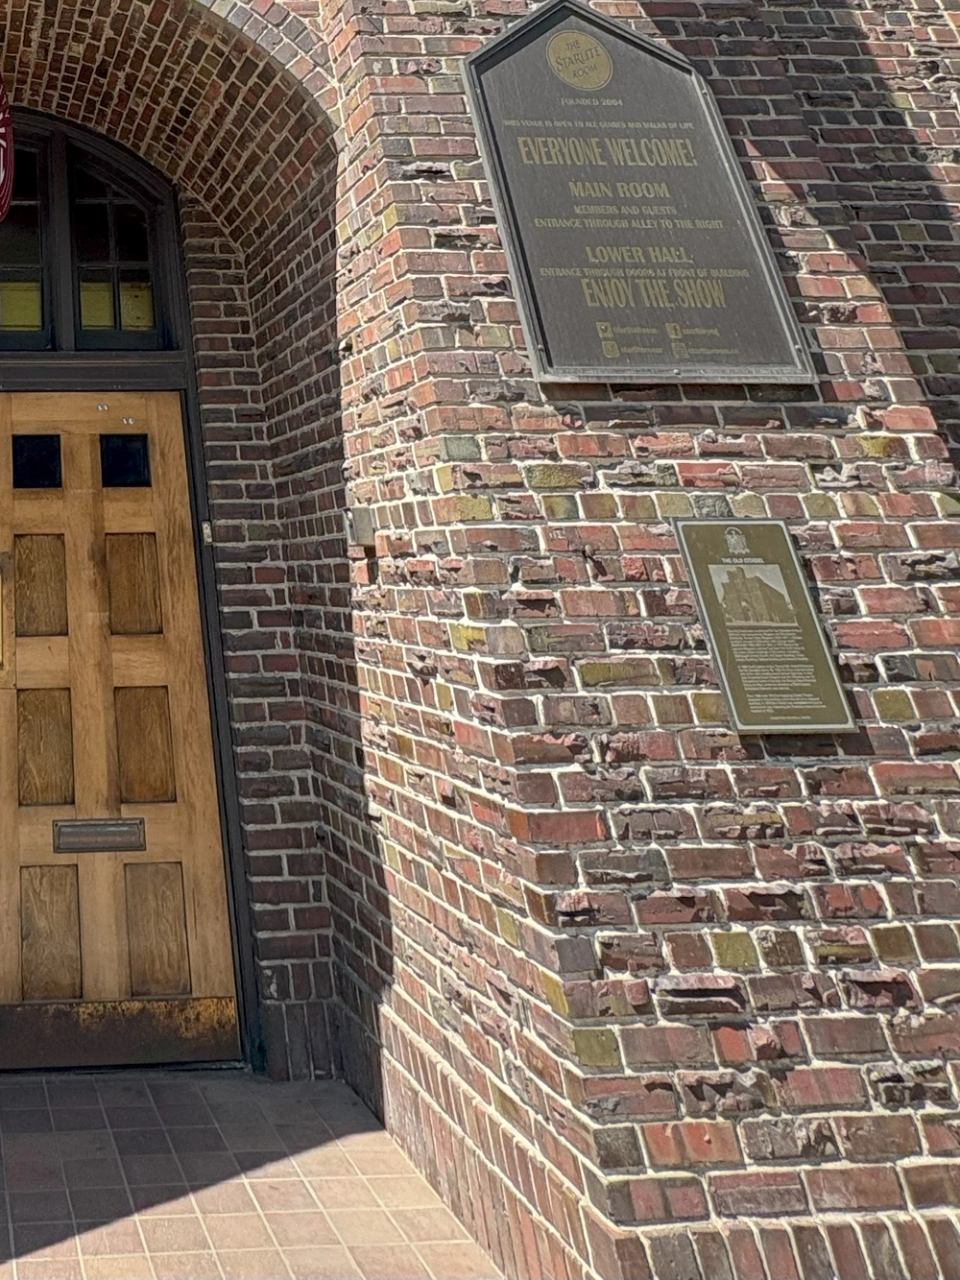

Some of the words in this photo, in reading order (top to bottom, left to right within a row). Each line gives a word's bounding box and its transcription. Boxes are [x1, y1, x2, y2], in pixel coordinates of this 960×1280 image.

[566, 40, 581, 51] THE
[555, 47, 600, 72] STARLITE
[573, 63, 599, 79] ROOM
[560, 97, 599, 106] FOUNDED
[517, 136, 608, 166] EVERYONE
[605, 136, 698, 167] WELCOME!
[568, 181, 613, 198] MAIN
[617, 182, 671, 198] ROOM
[574, 205, 617, 215] MEMBERS
[619, 206, 640, 215] AND
[641, 206, 678, 215] GUESTS
[534, 218, 583, 229] ENTRANCE
[584, 219, 630, 229] THROUGH
[631, 219, 659, 229] ALLEY
[660, 220, 672, 229] TO
[675, 220, 695, 229] THE
[696, 220, 724, 229] RIGHT
[585, 246, 646, 263] LOWER
[539, 268, 584, 277] ENTRANCE
[581, 278, 635, 309] ENJOY
[634, 278, 673, 308] THE
[672, 278, 727, 309] SHOW
